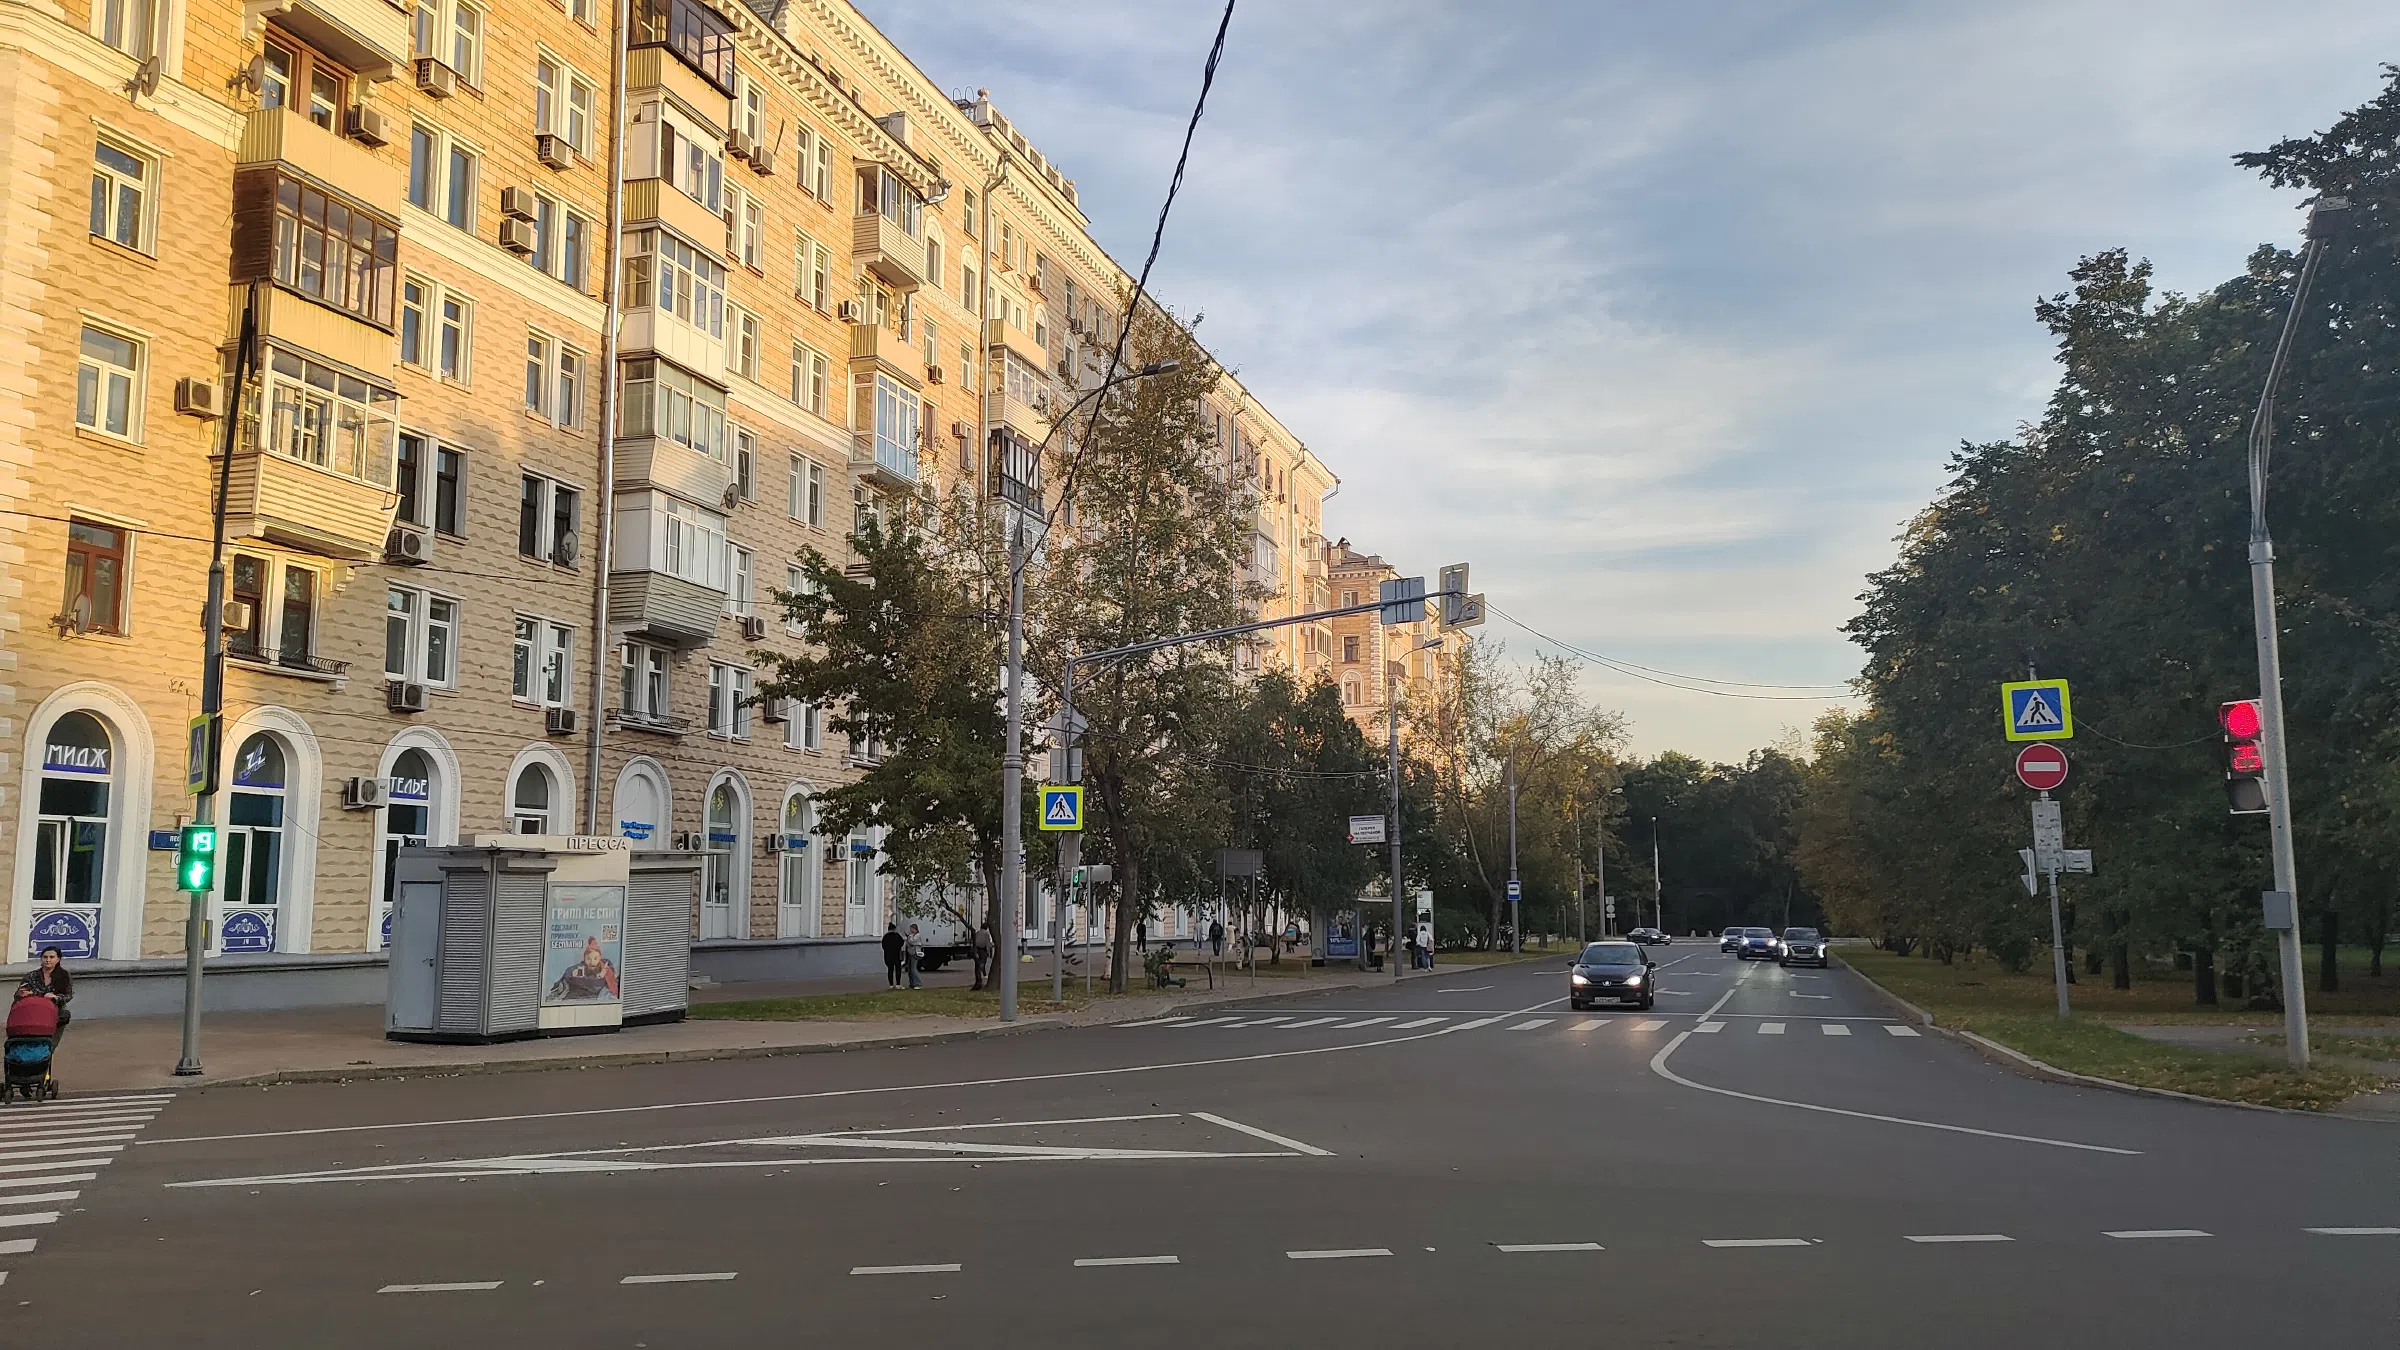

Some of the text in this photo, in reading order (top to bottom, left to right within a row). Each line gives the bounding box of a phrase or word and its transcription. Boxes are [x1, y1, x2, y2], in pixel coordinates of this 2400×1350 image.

[193, 832, 217, 852] 19
[567, 837, 627, 850] ПРЕССА
[551, 907, 620, 919] ГРИПП НЕ СПИТ
